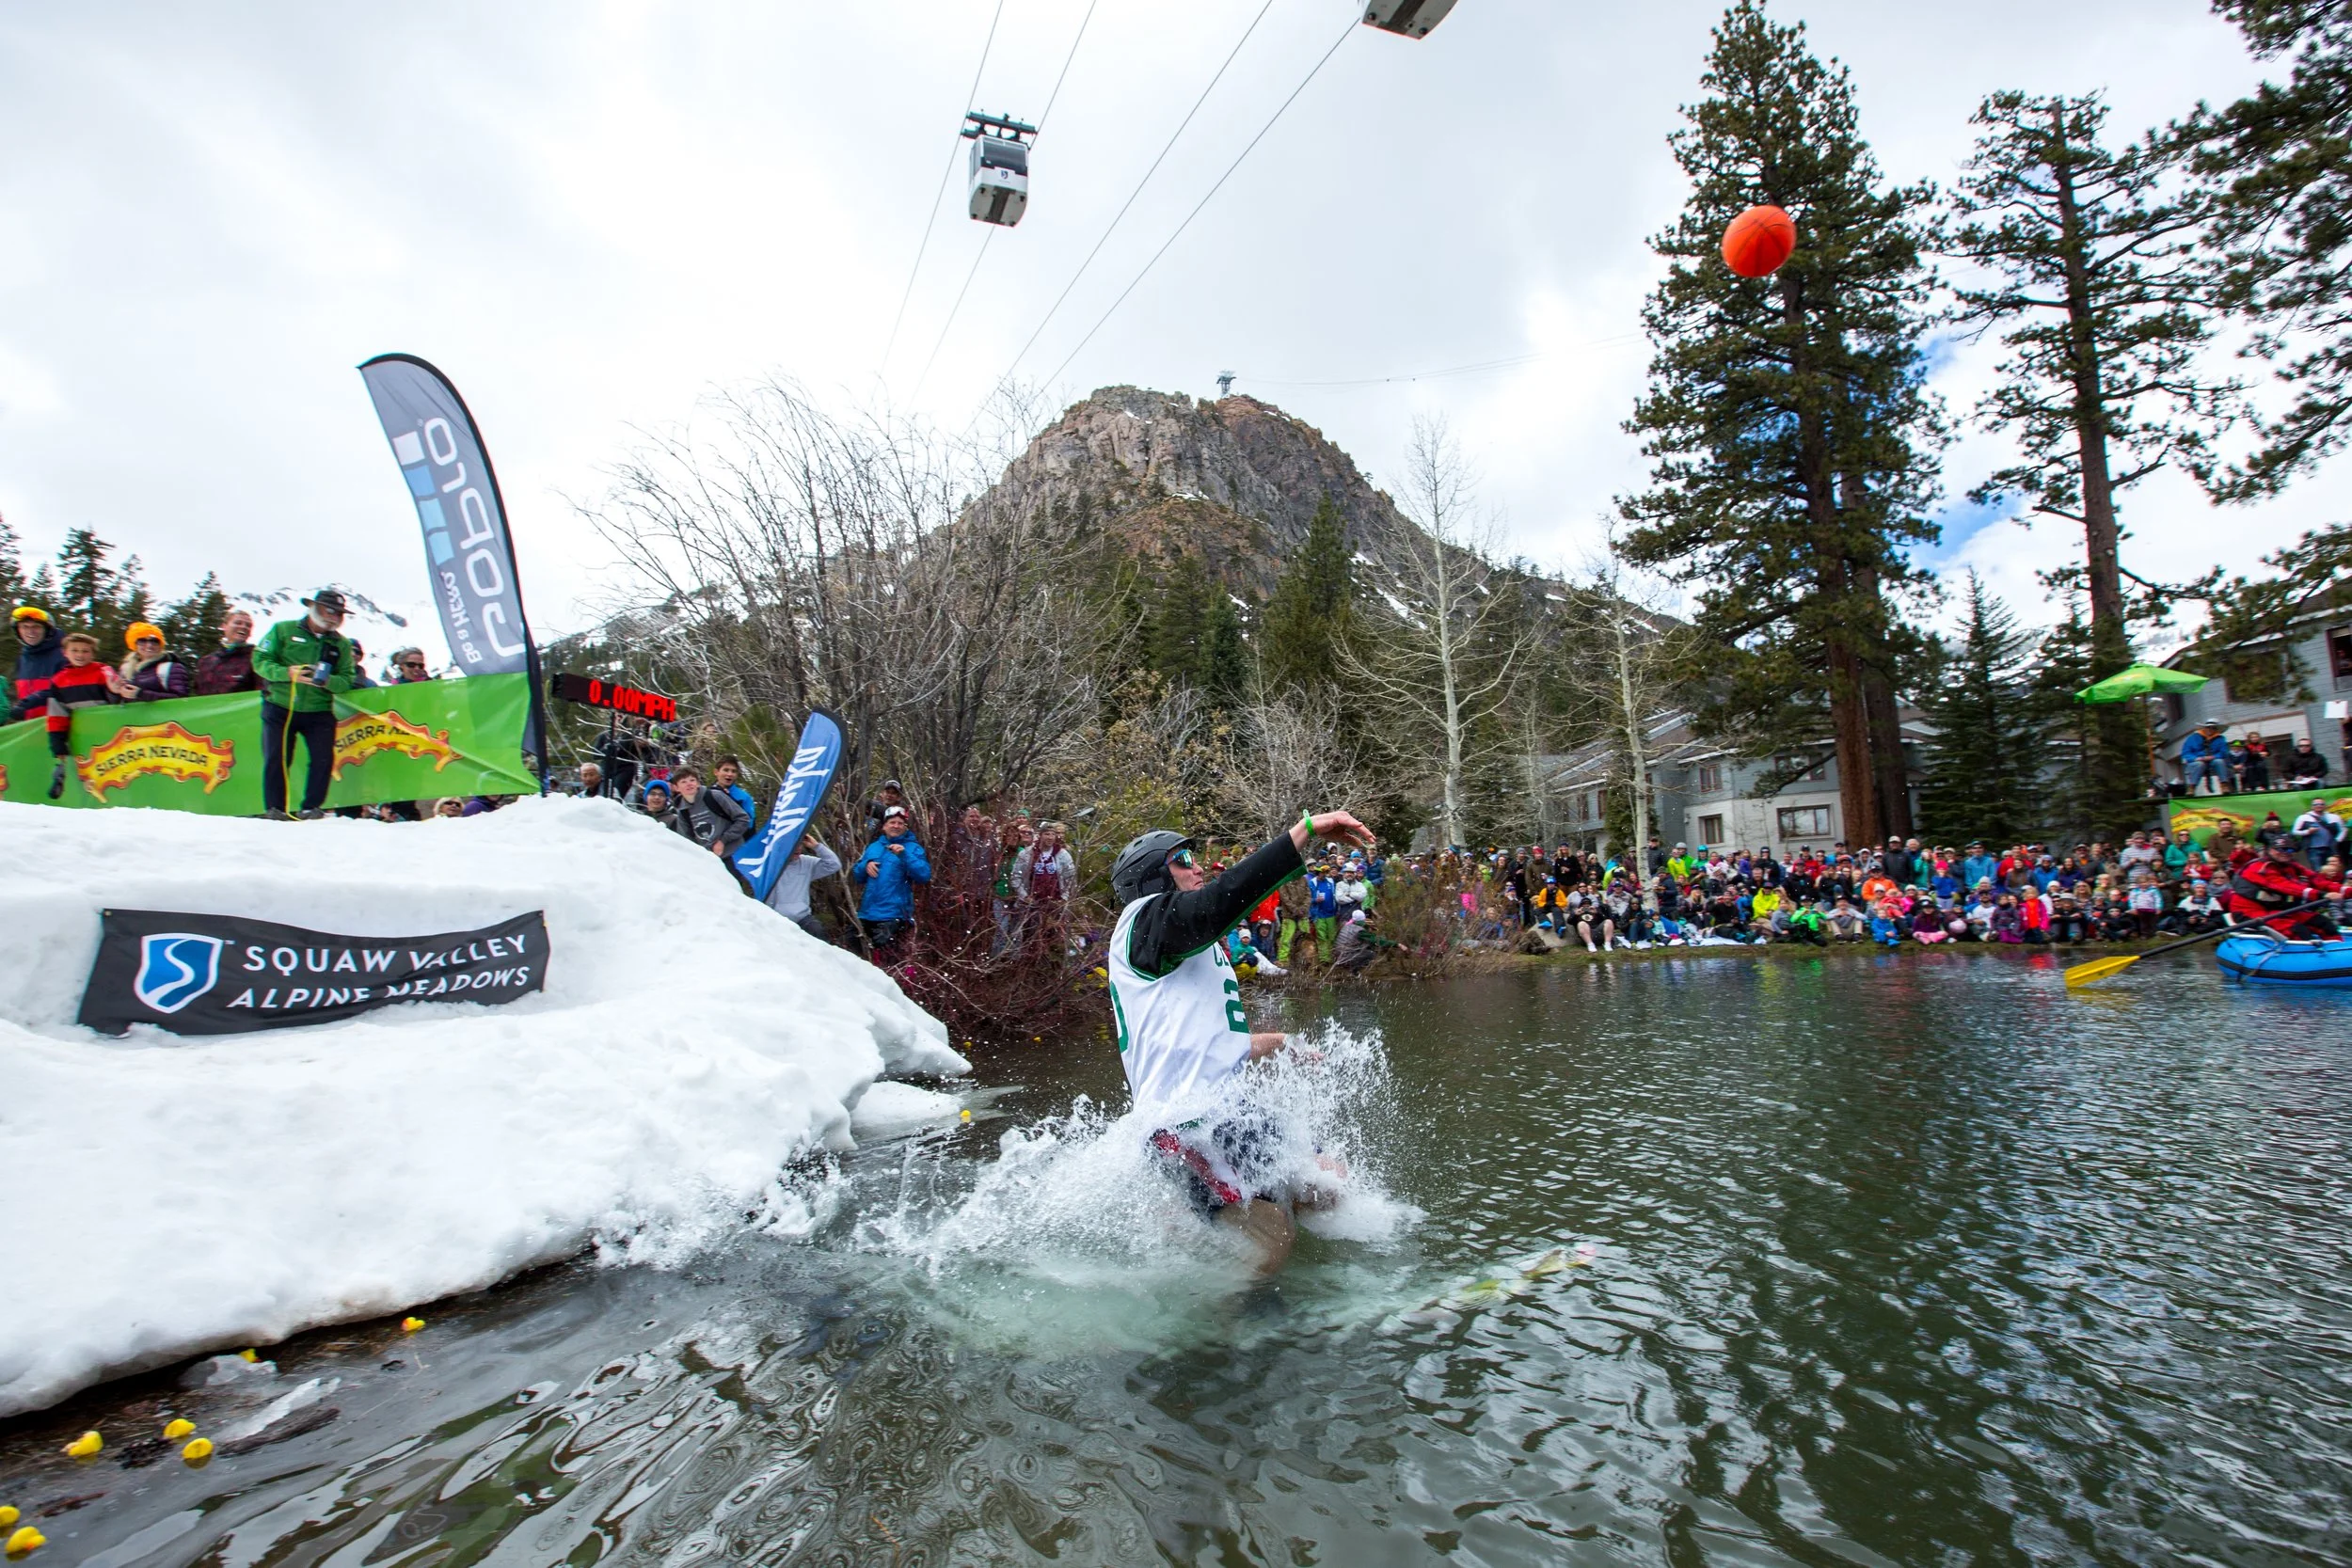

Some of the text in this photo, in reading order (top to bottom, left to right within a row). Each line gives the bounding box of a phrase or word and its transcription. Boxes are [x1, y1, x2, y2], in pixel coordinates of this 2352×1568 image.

[334, 724, 386, 752] SIERRA
[95, 745, 209, 777] SIERRA NEVADA
[242, 934, 525, 976] SQUAW VALLEY
[226, 966, 531, 1008] ALPINE MEADOWS
